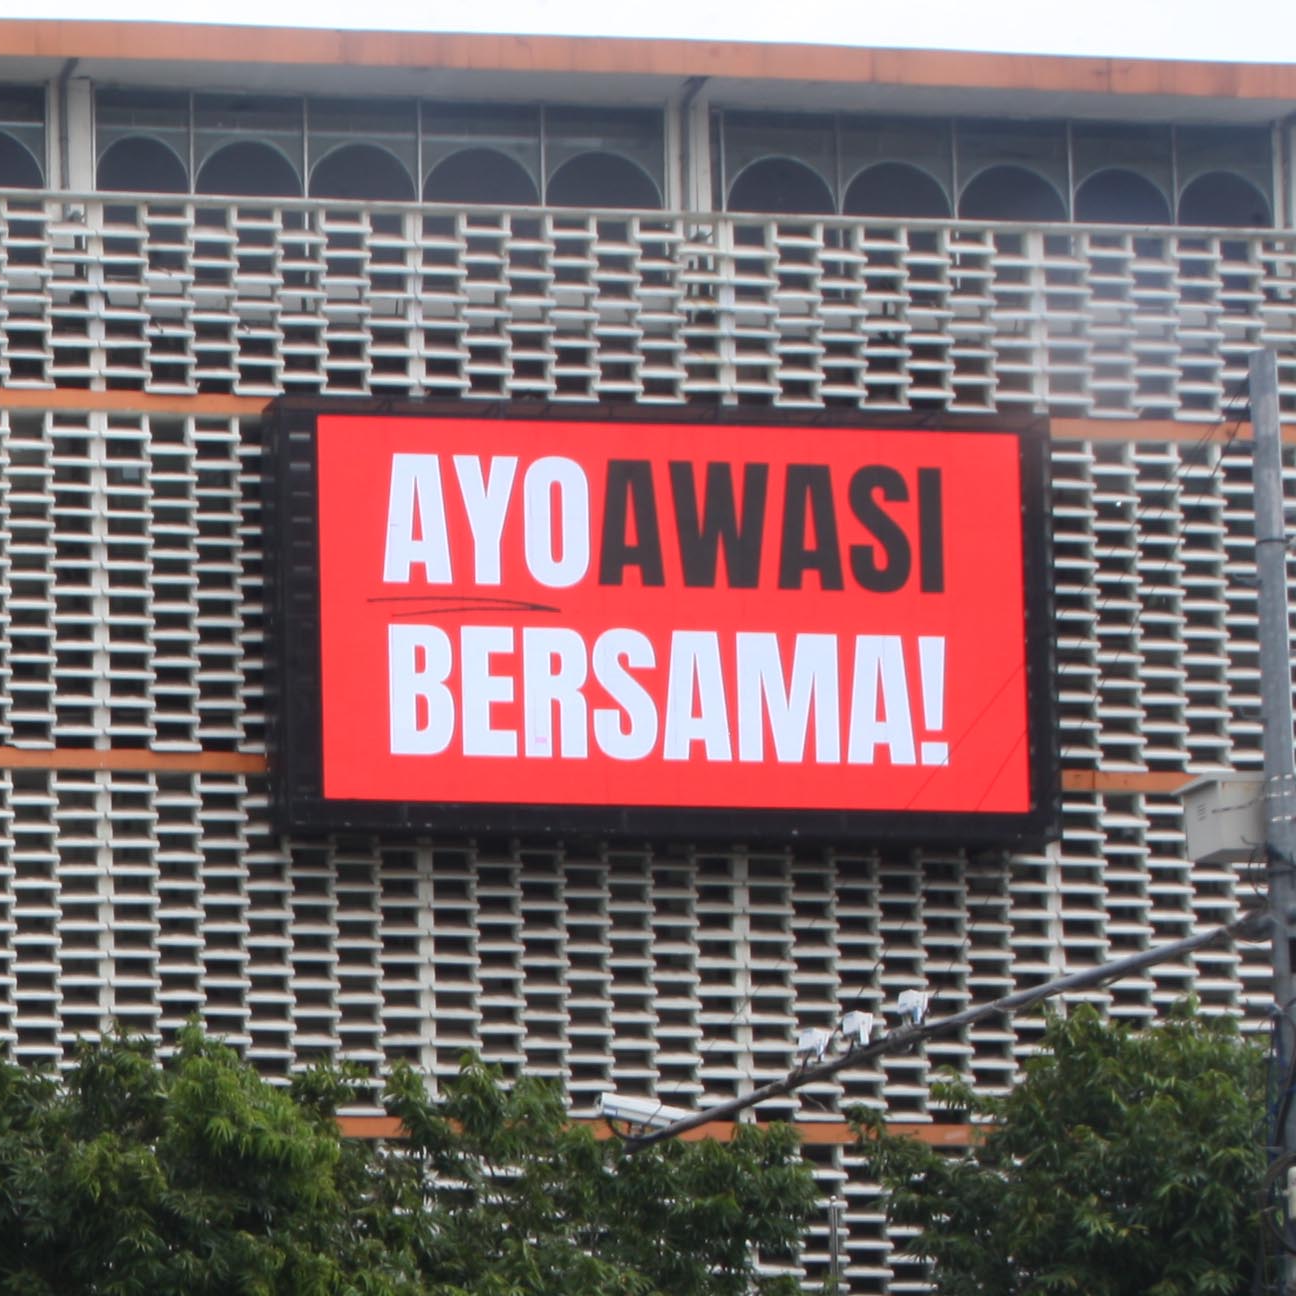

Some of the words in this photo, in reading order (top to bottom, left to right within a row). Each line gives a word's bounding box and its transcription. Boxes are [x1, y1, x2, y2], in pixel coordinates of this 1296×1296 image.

[383, 452, 590, 588] AYO
[598, 458, 945, 594] AWASI
[387, 622, 950, 767] BERSAMA!
